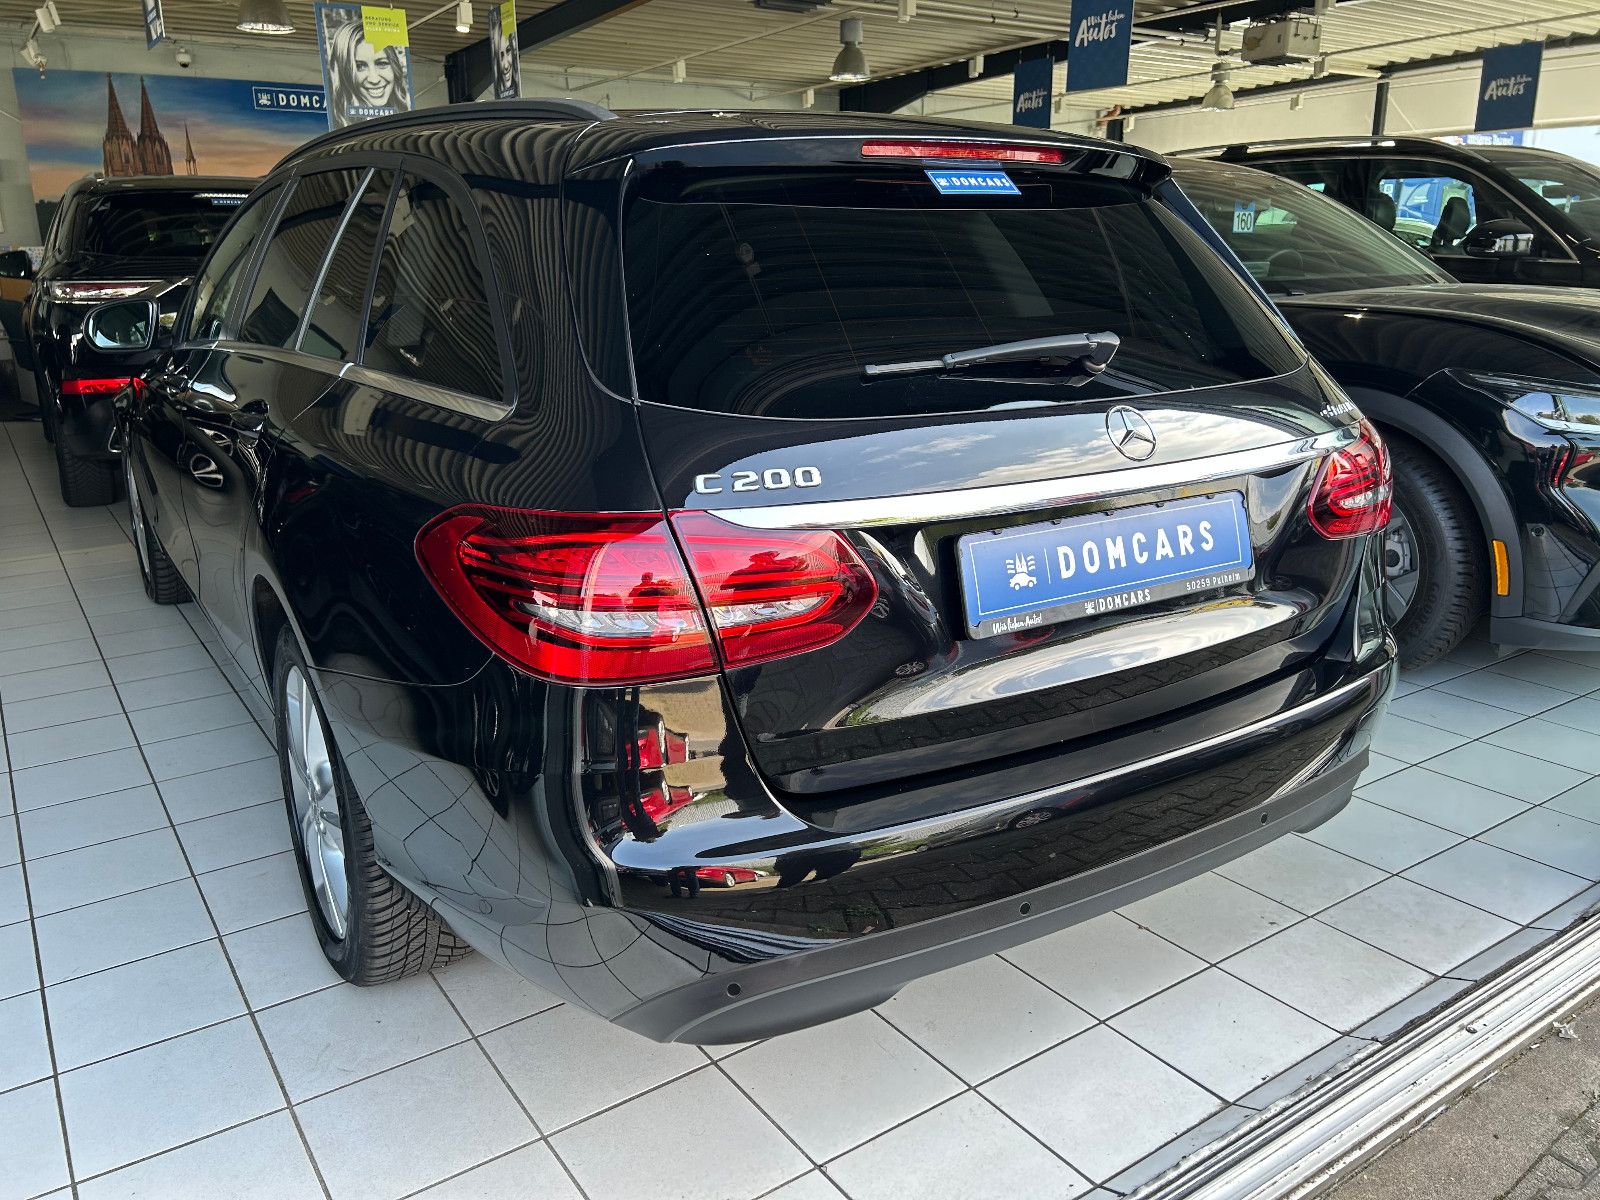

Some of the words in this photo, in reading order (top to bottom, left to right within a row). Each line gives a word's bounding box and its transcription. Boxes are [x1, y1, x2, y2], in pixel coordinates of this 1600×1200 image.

[1074, 13, 1118, 47] Autos
[1484, 77, 1526, 101] Autos
[278, 94, 327, 109] DOMC
[358, 108, 394, 116] DOMCARS
[1016, 90, 1044, 113] Autos
[951, 177, 1011, 187] DOMCARS
[1236, 212, 1253, 231] 160
[694, 472, 723, 495] C
[731, 466, 822, 493] 200
[1056, 520, 1215, 580] DOMCARS
[1186, 577, 1211, 591] 50259
[1212, 572, 1241, 586] Pulheim
[1098, 588, 1151, 612] DOMCARS
